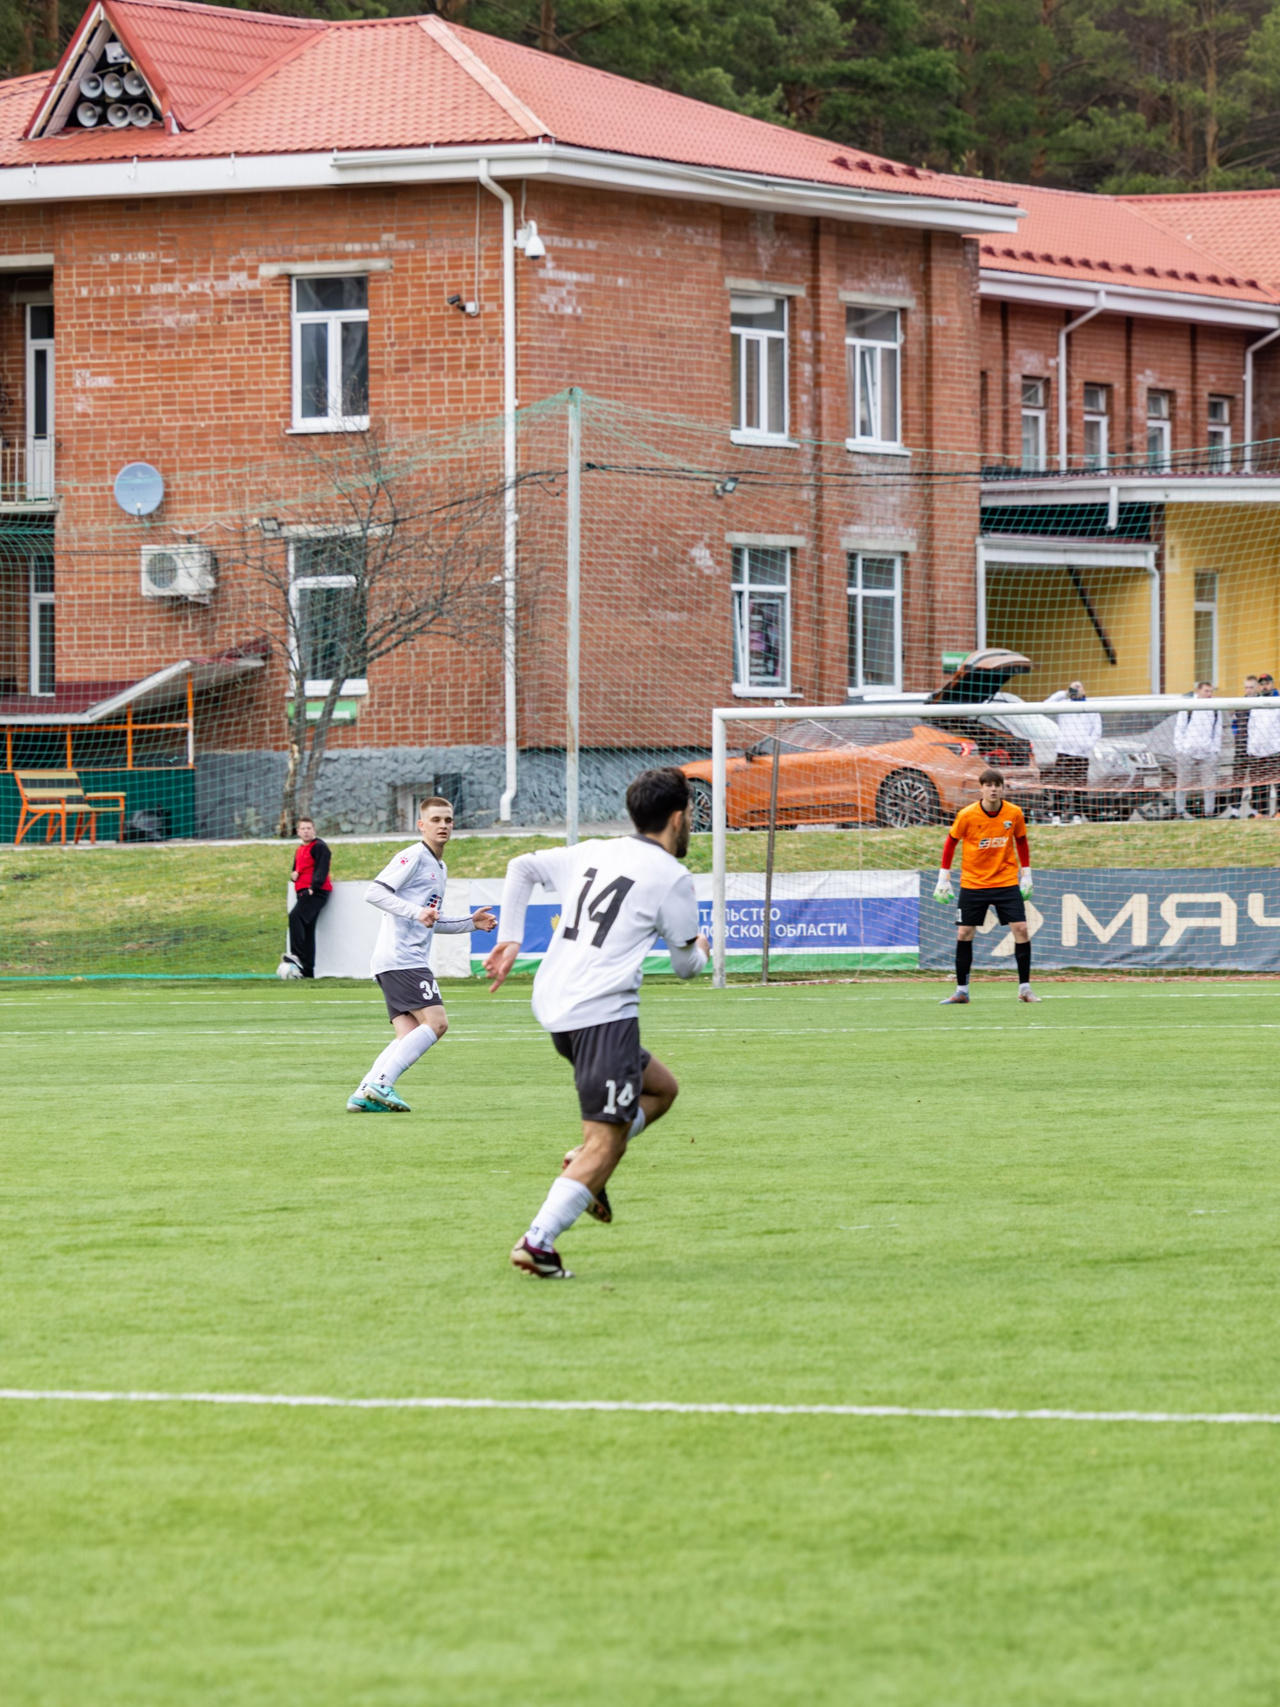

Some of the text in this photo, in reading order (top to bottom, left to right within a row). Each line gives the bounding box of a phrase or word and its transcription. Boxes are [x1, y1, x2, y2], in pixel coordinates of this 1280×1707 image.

[563, 867, 635, 949] 14
[697, 907, 781, 922] ТЛЬСТВО
[775, 922, 848, 938] ОБЛАСТИ
[419, 980, 442, 1001] 34
[603, 1079, 635, 1115] 14
